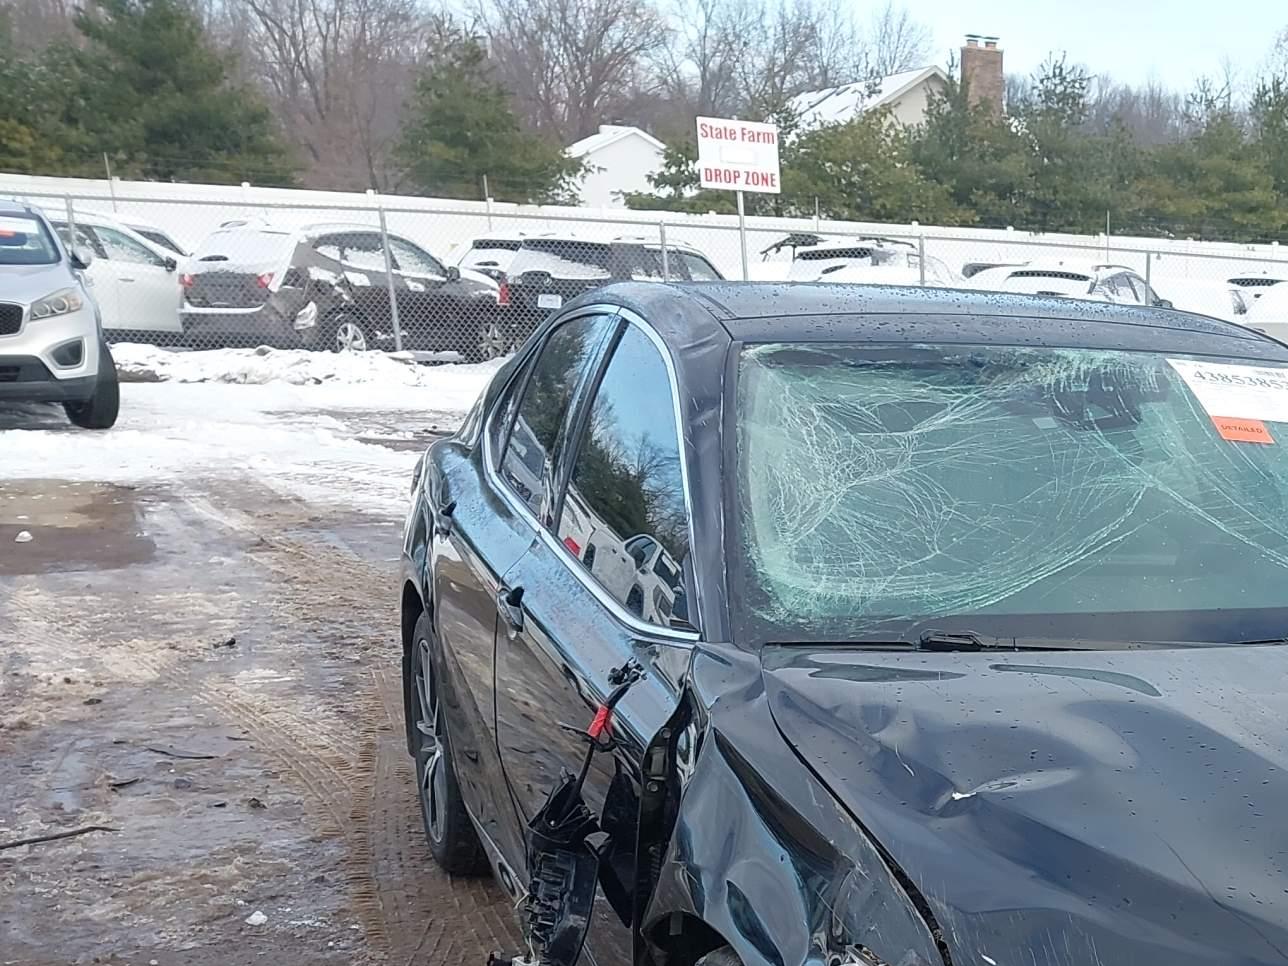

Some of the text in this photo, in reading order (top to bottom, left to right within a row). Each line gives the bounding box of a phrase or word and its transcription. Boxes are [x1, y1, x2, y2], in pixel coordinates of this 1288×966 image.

[700, 123, 775, 144] State Farm
[704, 168, 777, 187] DROP ZONE
